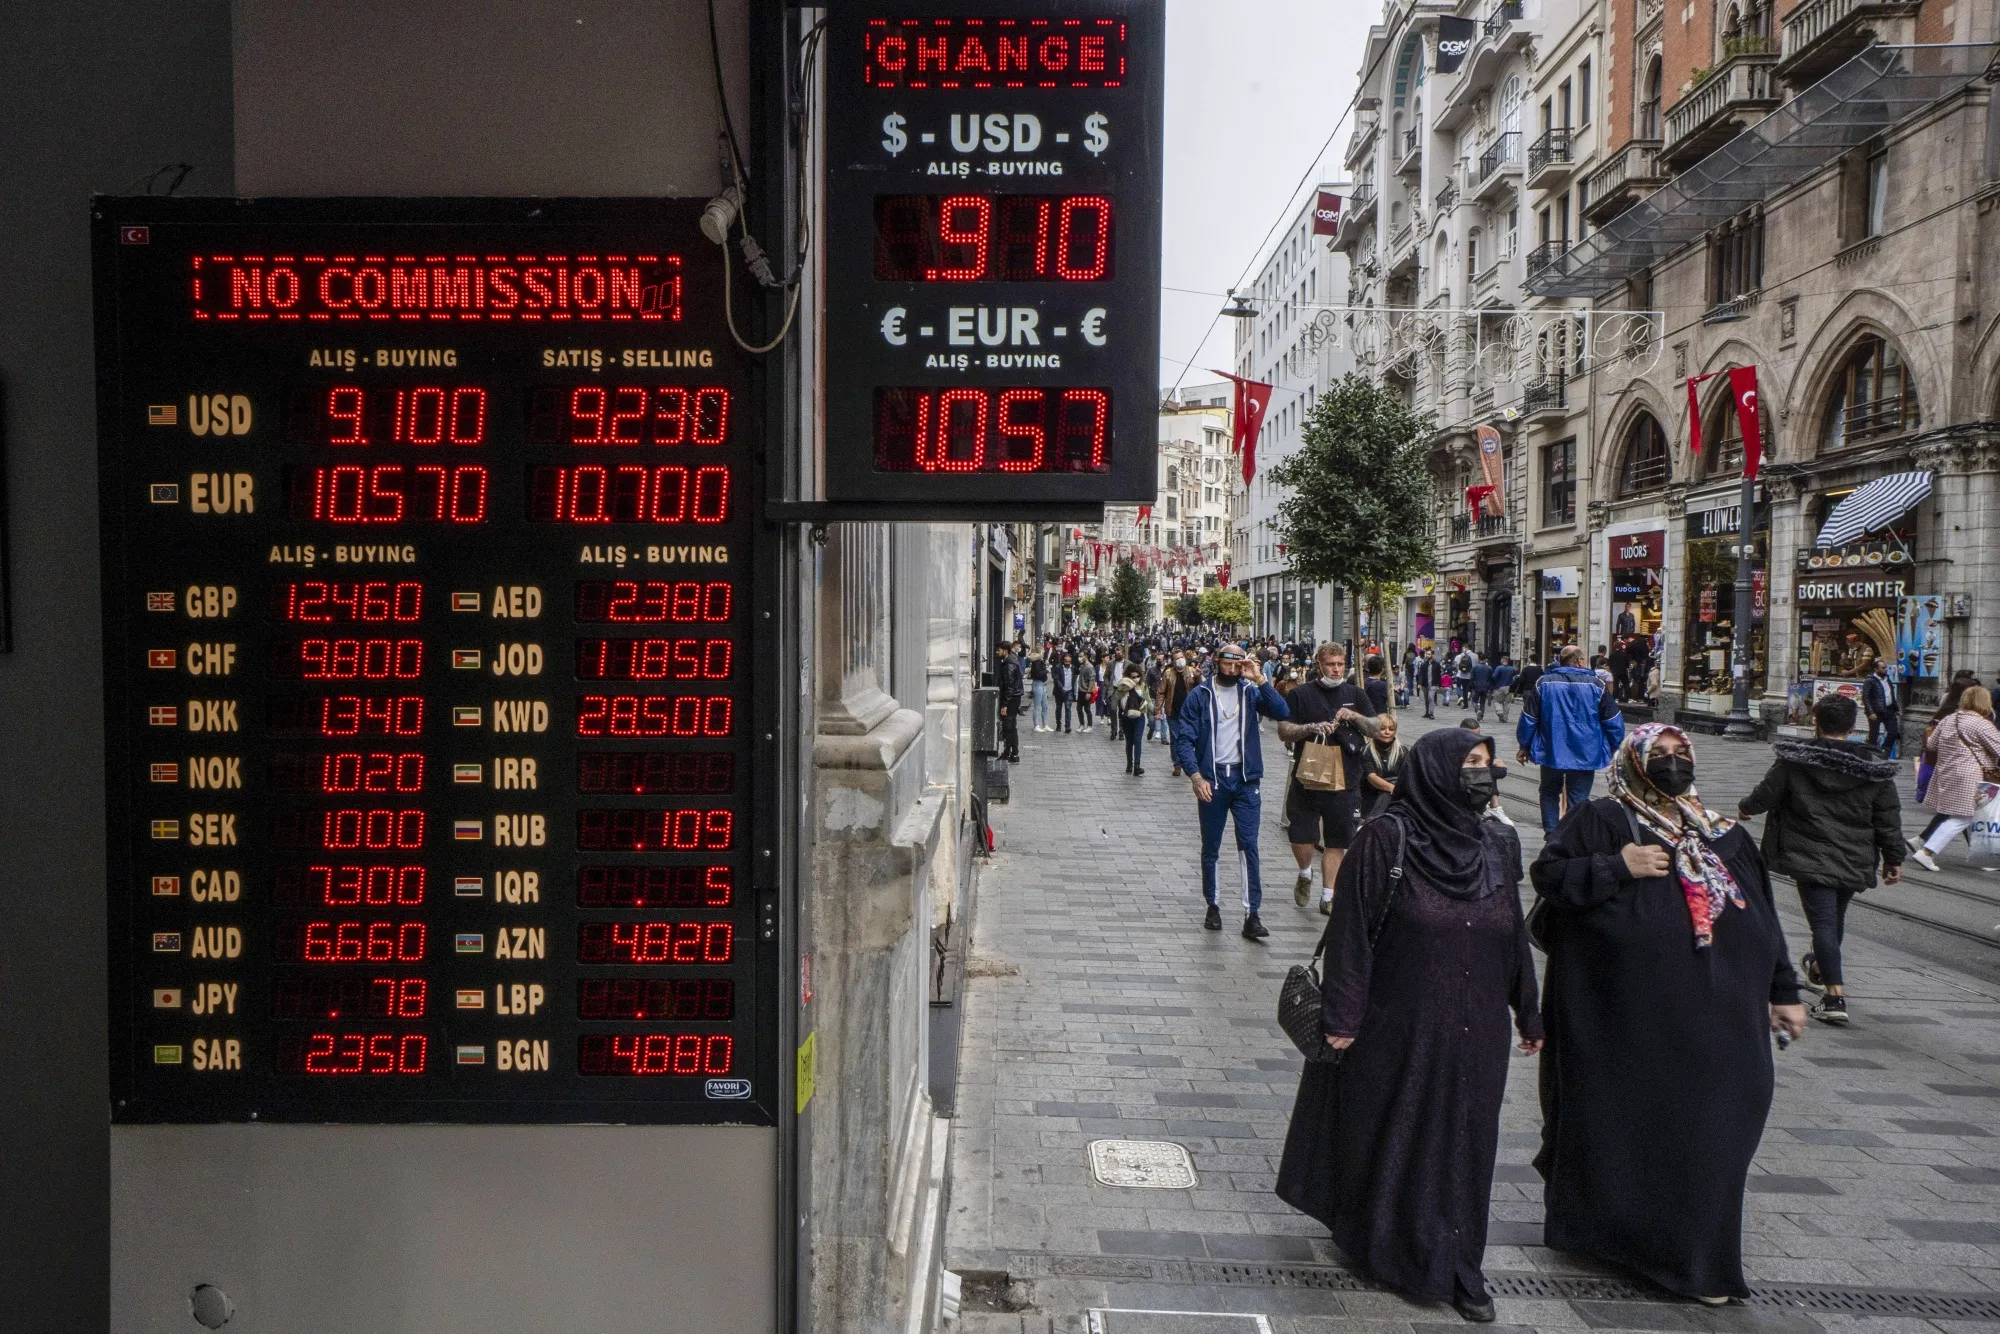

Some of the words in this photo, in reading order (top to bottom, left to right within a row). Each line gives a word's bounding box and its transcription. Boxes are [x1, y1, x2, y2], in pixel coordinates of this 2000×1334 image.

[878, 36, 1105, 71] CHANGE
[1438, 39, 1470, 52] OGM
[951, 114, 1041, 152] USD
[927, 162, 970, 179] ALIŞ
[986, 162, 1063, 175] BUYING
[1317, 210, 1338, 219] OGM
[232, 268, 299, 308] NO
[319, 267, 639, 308] COMMISSION
[949, 308, 1040, 346] EUR
[310, 350, 355, 371] ALIŞ
[377, 350, 456, 366] BUYING
[544, 350, 602, 371] SATIŞ
[623, 350, 712, 367] SELLING
[926, 354, 968, 371] ALIŞ
[987, 354, 1060, 368] BUYING
[190, 395, 251, 435] USD
[191, 473, 253, 513] EUR
[270, 546, 314, 567] ALIŞ
[336, 546, 415, 562] BUYING
[581, 546, 626, 567] ALIŞ
[648, 546, 728, 563] BUYING
[1620, 544, 1647, 560] TUDORS
[187, 586, 236, 617] GBP
[493, 586, 541, 617] AED
[1799, 581, 1842, 600] BÖREK
[1848, 580, 1905, 598] CENTER
[188, 643, 235, 674] CHF
[493, 643, 542, 675] JOD
[189, 701, 237, 731] DKK
[494, 701, 548, 732] KWD
[190, 757, 241, 788] NOK
[495, 758, 536, 789] IRR
[190, 814, 236, 845] SEK
[495, 815, 545, 846] RUB
[191, 870, 239, 902] CAD
[496, 871, 538, 904] IQR
[192, 927, 241, 958] AUD
[496, 928, 544, 959] AZN
[193, 983, 237, 1014] JPY
[497, 984, 544, 1015] LBP
[193, 1039, 240, 1070] SAR
[498, 1040, 548, 1071] BGN
